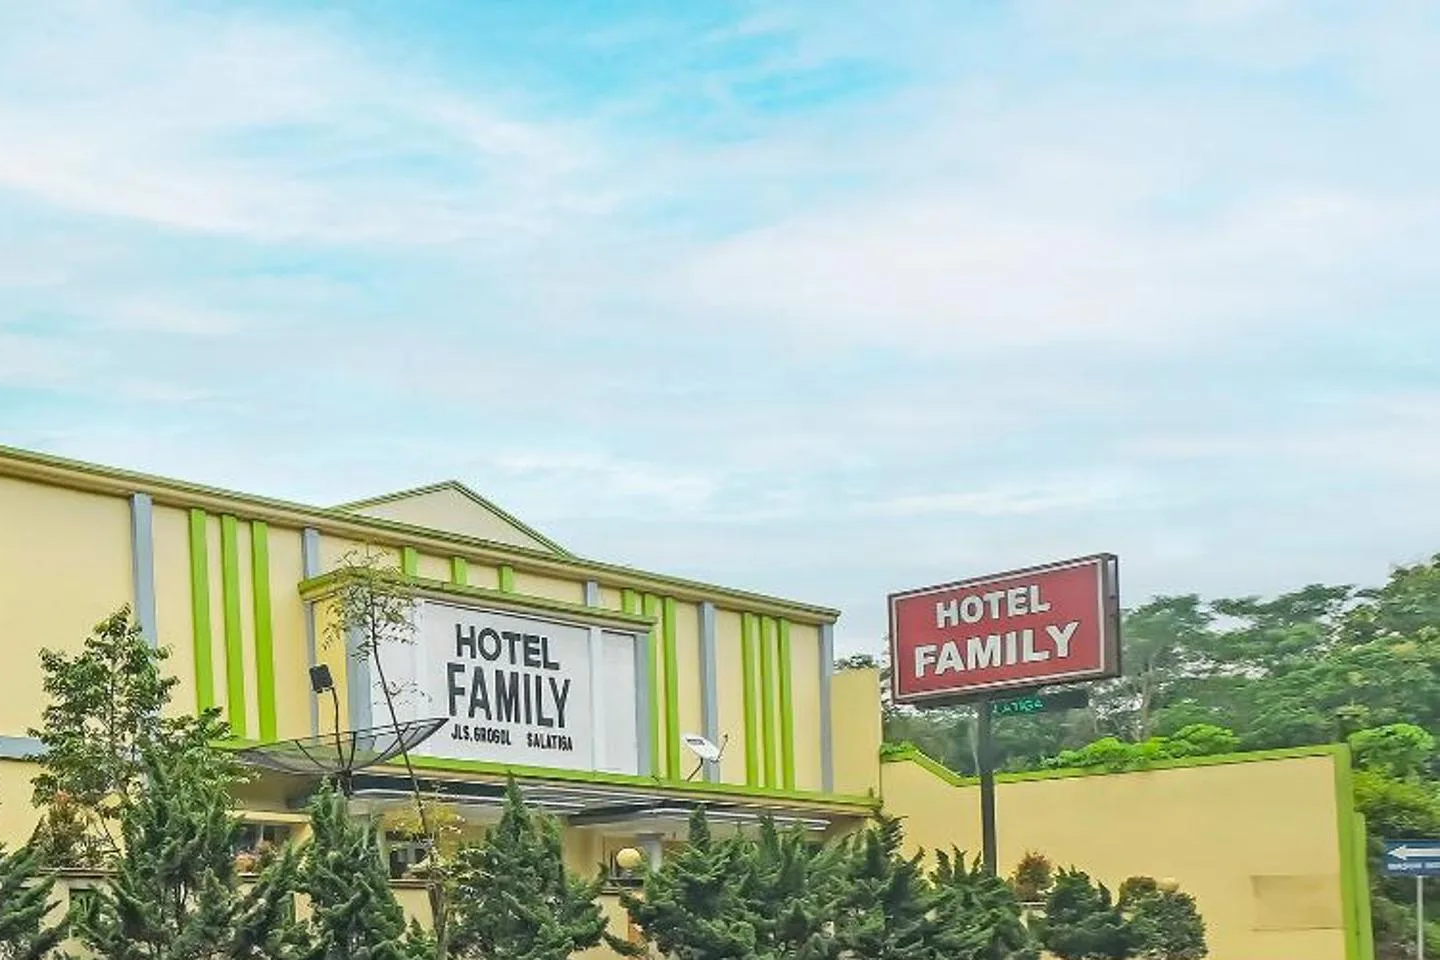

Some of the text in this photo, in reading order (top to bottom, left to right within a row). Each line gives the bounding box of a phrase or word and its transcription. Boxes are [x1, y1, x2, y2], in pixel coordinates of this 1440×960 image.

[936, 585, 1051, 629] HOTEL
[455, 623, 560, 671] HOTEL
[914, 621, 1080, 678] FAMILY
[446, 662, 571, 729] FAMILY
[527, 732, 573, 751] SALATIGA
